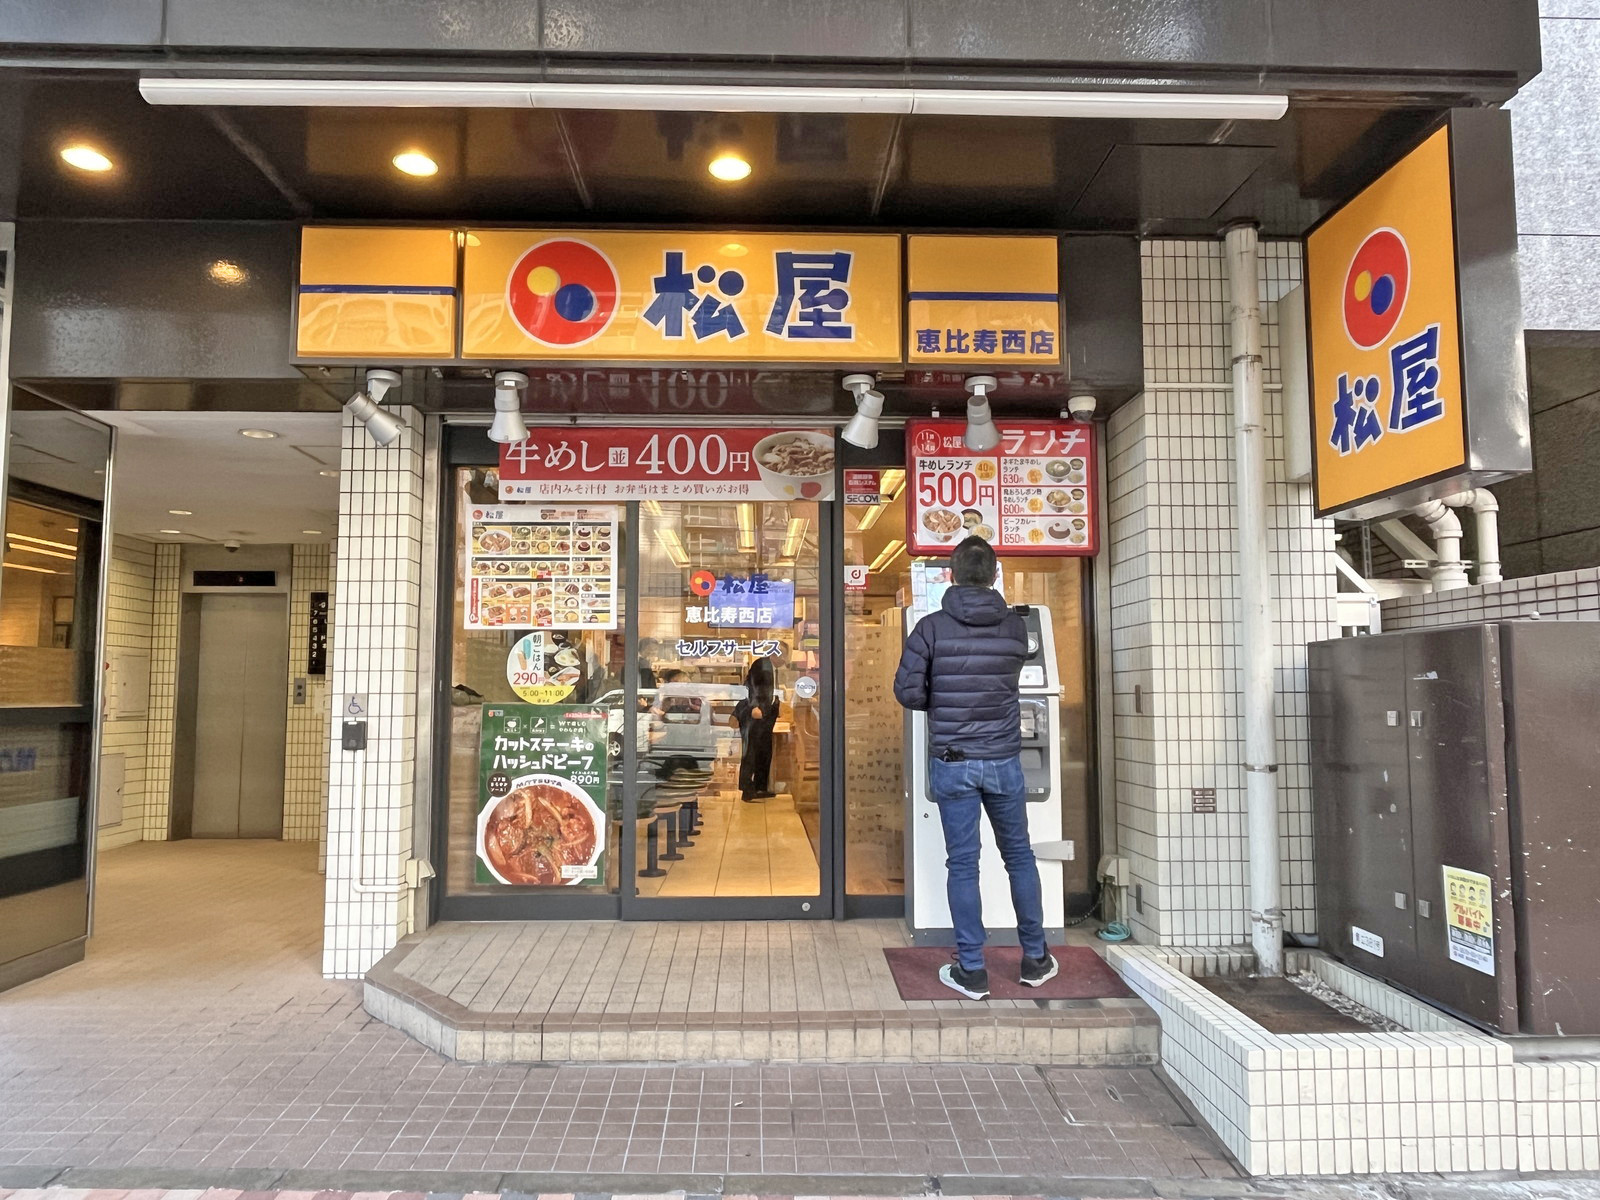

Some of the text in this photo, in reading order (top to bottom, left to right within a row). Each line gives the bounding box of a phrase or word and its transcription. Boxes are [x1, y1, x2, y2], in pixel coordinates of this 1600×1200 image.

[642, 250, 853, 341] 松屋
[916, 328, 1055, 354] 恵比寿西店
[1329, 322, 1446, 457] 松屋
[505, 433, 750, 475] 牛めし 並 400円
[919, 460, 973, 470] 牛めしランチ
[539, 483, 607, 495] 店内みそ汁付
[614, 483, 750, 495] お弁当はまとめ買いがお得
[919, 471, 995, 507] 500円
[846, 494, 879, 503] SECOM
[721, 573, 769, 595] 松屋
[685, 606, 773, 624] 恵比寿西店
[532, 634, 542, 671] 朝ごはん
[676, 639, 782, 656] セルフサービス
[494, 735, 595, 752] カットステーキの
[493, 753, 594, 770] ハッシュドビーフ
[570, 775, 600, 785] 890円
[1453, 902, 1485, 920] アルバイト
